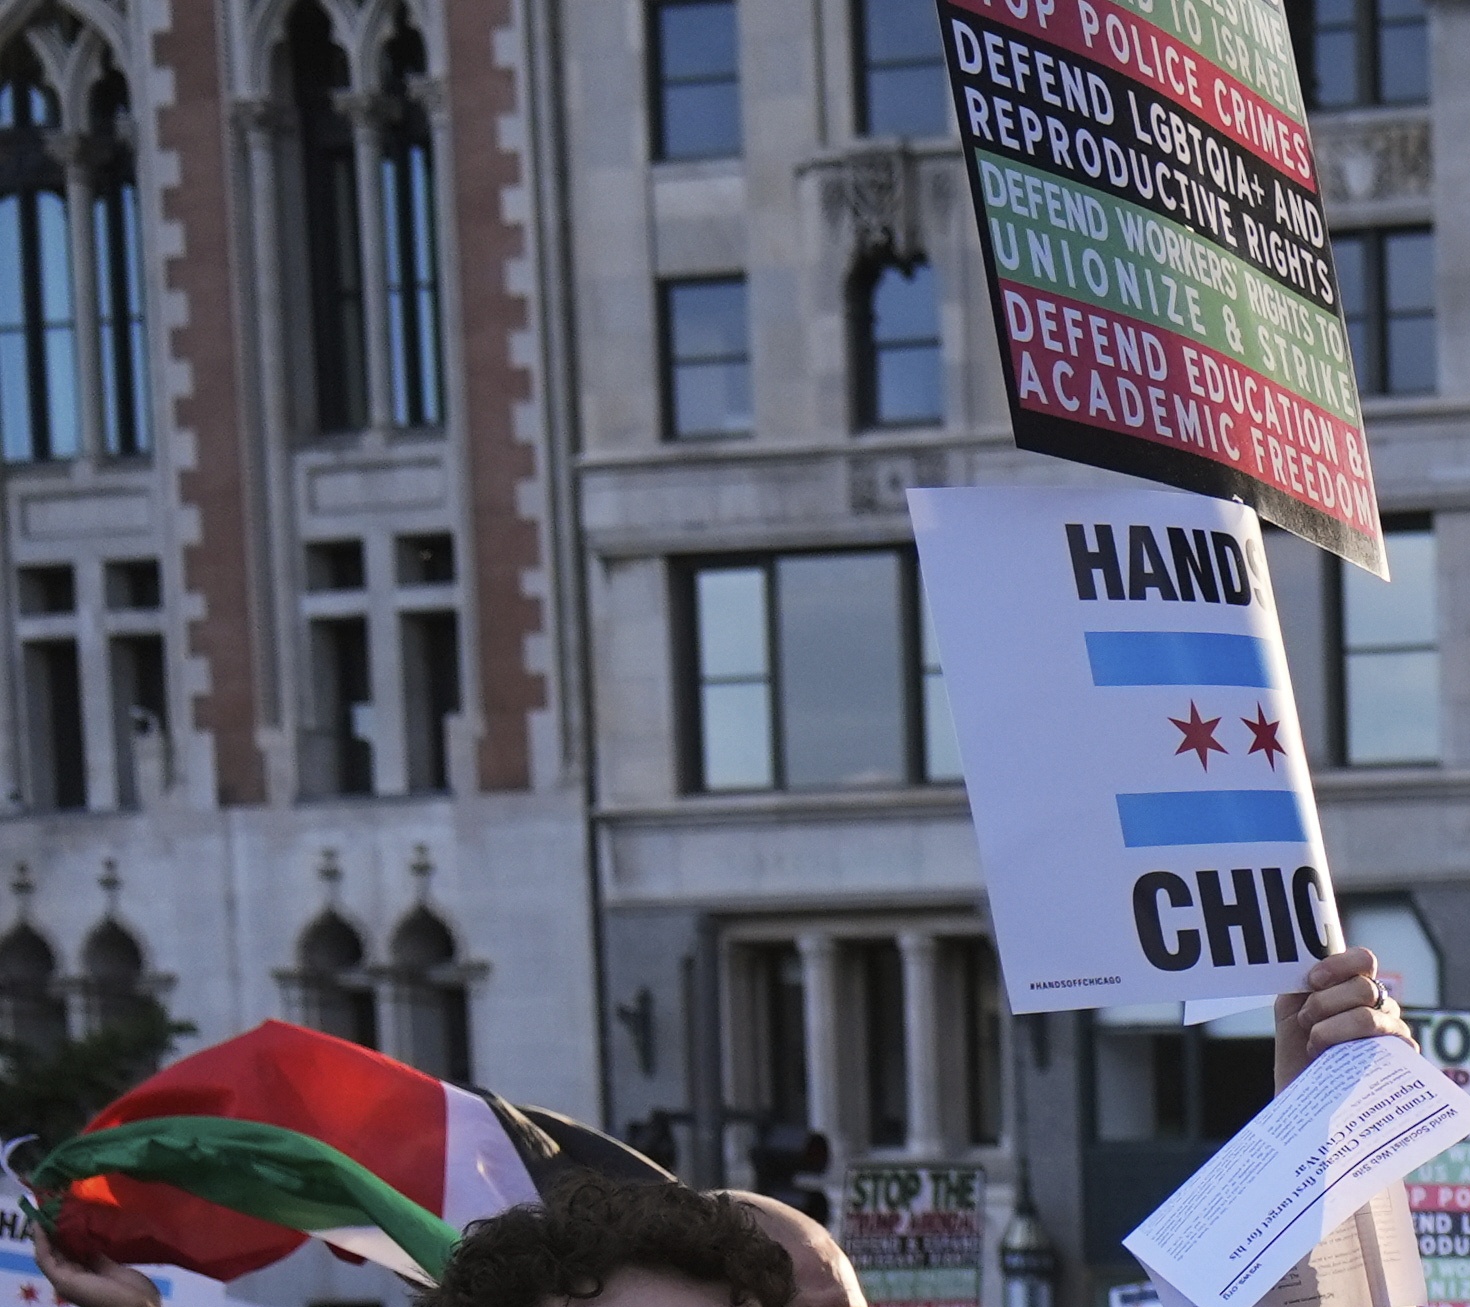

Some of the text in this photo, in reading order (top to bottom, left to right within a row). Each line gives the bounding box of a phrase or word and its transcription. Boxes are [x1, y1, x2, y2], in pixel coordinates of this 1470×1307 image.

[1204, 0, 1288, 64] ESTINE
[1211, 16, 1298, 115] ISRAEL
[951, 18, 1324, 249] DEFEND LGBTQIA+ AND
[1078, 0, 1312, 180] POLICE CRIMES
[963, 86, 1334, 306] REPRODUCTIVE RIGHTS
[980, 159, 1344, 364] DEFEND WORKERS' RIGHTS TO
[989, 217, 1356, 419] UNIONIZE & STRIKE
[1004, 289, 1365, 480] DEFEND EDUCATION &
[1019, 351, 1374, 531] ACADEMIC FREEDOM
[1064, 522, 1274, 612] HANDS
[1132, 865, 1335, 973] CHIC
[1317, 1129, 1347, 1156] Civil
[1345, 1119, 1359, 1133] of
[1351, 1107, 1458, 1179] World Socialist Web Site
[1358, 1078, 1425, 1123] Department
[1228, 1088, 1438, 1263] Trump makes Chicago first target for his
[1292, 1153, 1320, 1179] War
[1221, 1262, 1262, 1302] wsws.org
